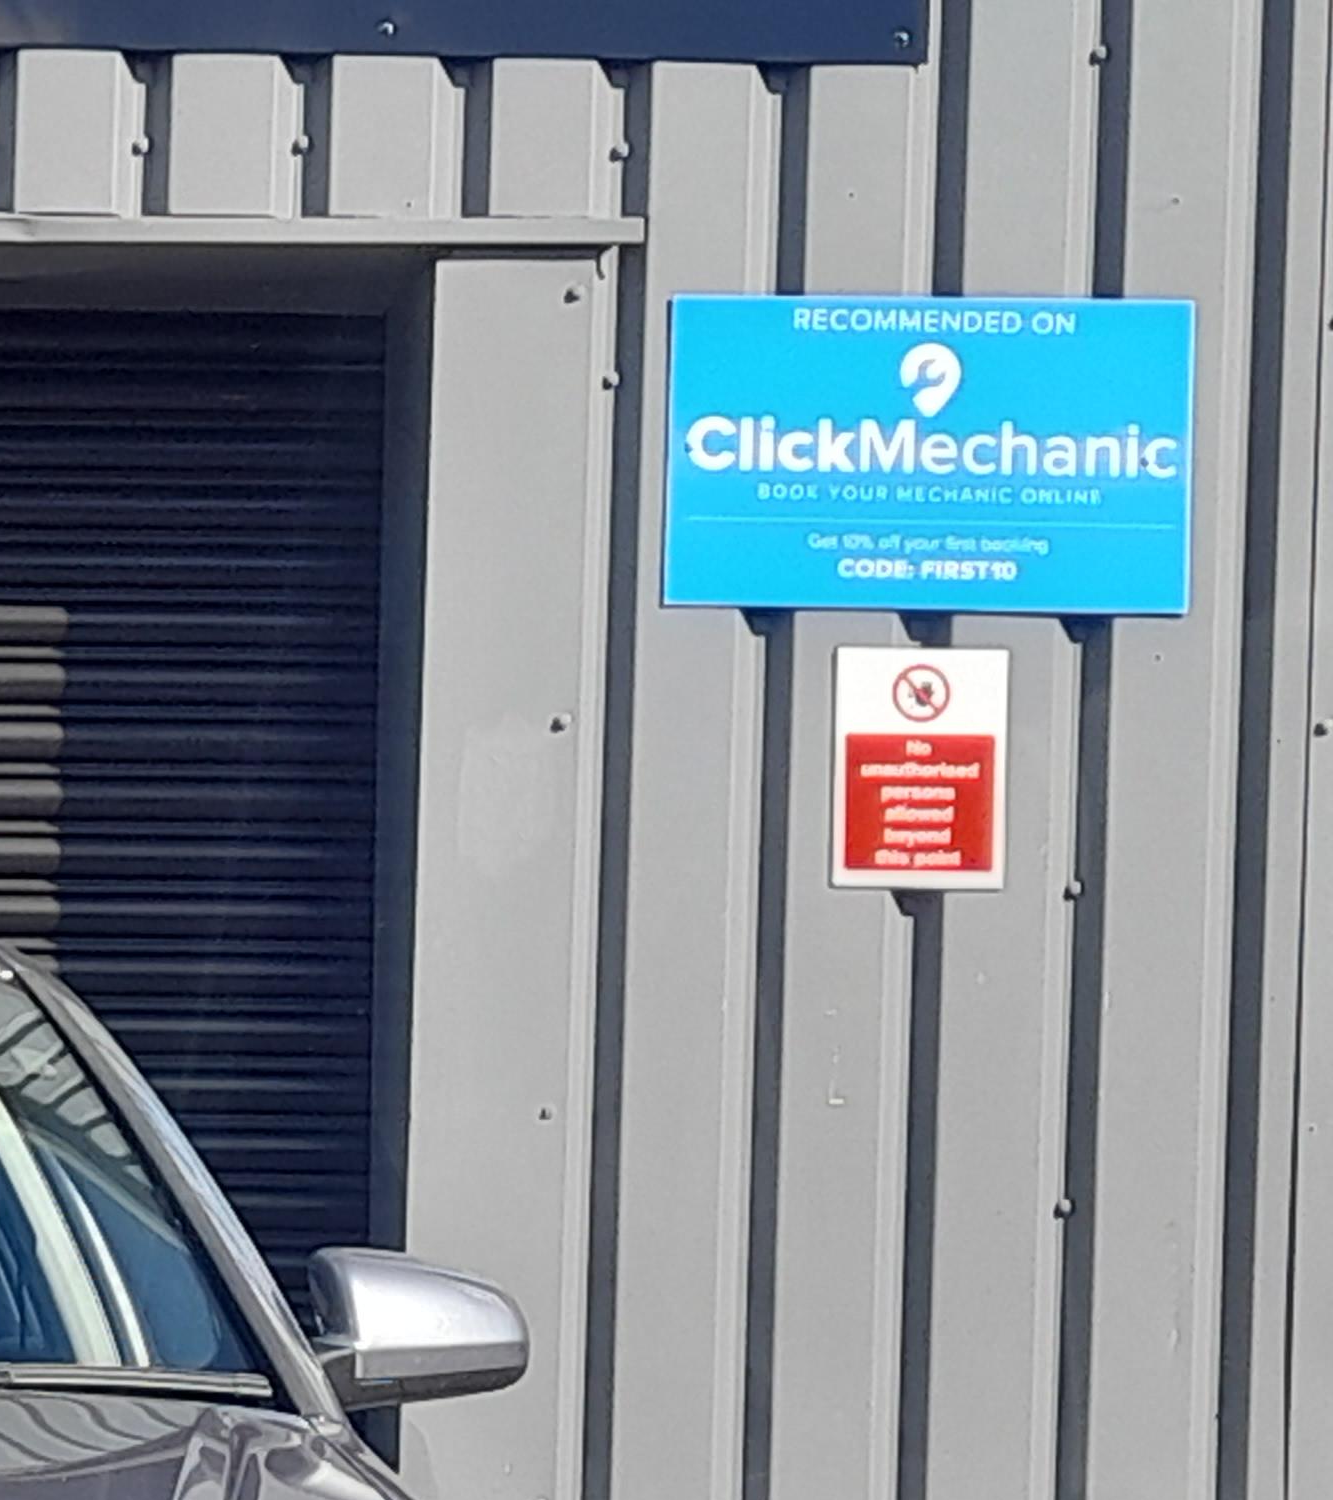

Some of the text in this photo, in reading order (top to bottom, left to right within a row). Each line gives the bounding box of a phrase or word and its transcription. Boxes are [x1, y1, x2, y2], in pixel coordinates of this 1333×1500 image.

[792, 308, 1076, 334] RECOMMENDED ON
[686, 415, 1178, 479] ClickMechanic
[757, 482, 1100, 505] BOOK YOUR MECHANIC ONLINE
[807, 532, 838, 549] Get
[903, 536, 939, 554] your
[837, 558, 915, 579] CODE:
